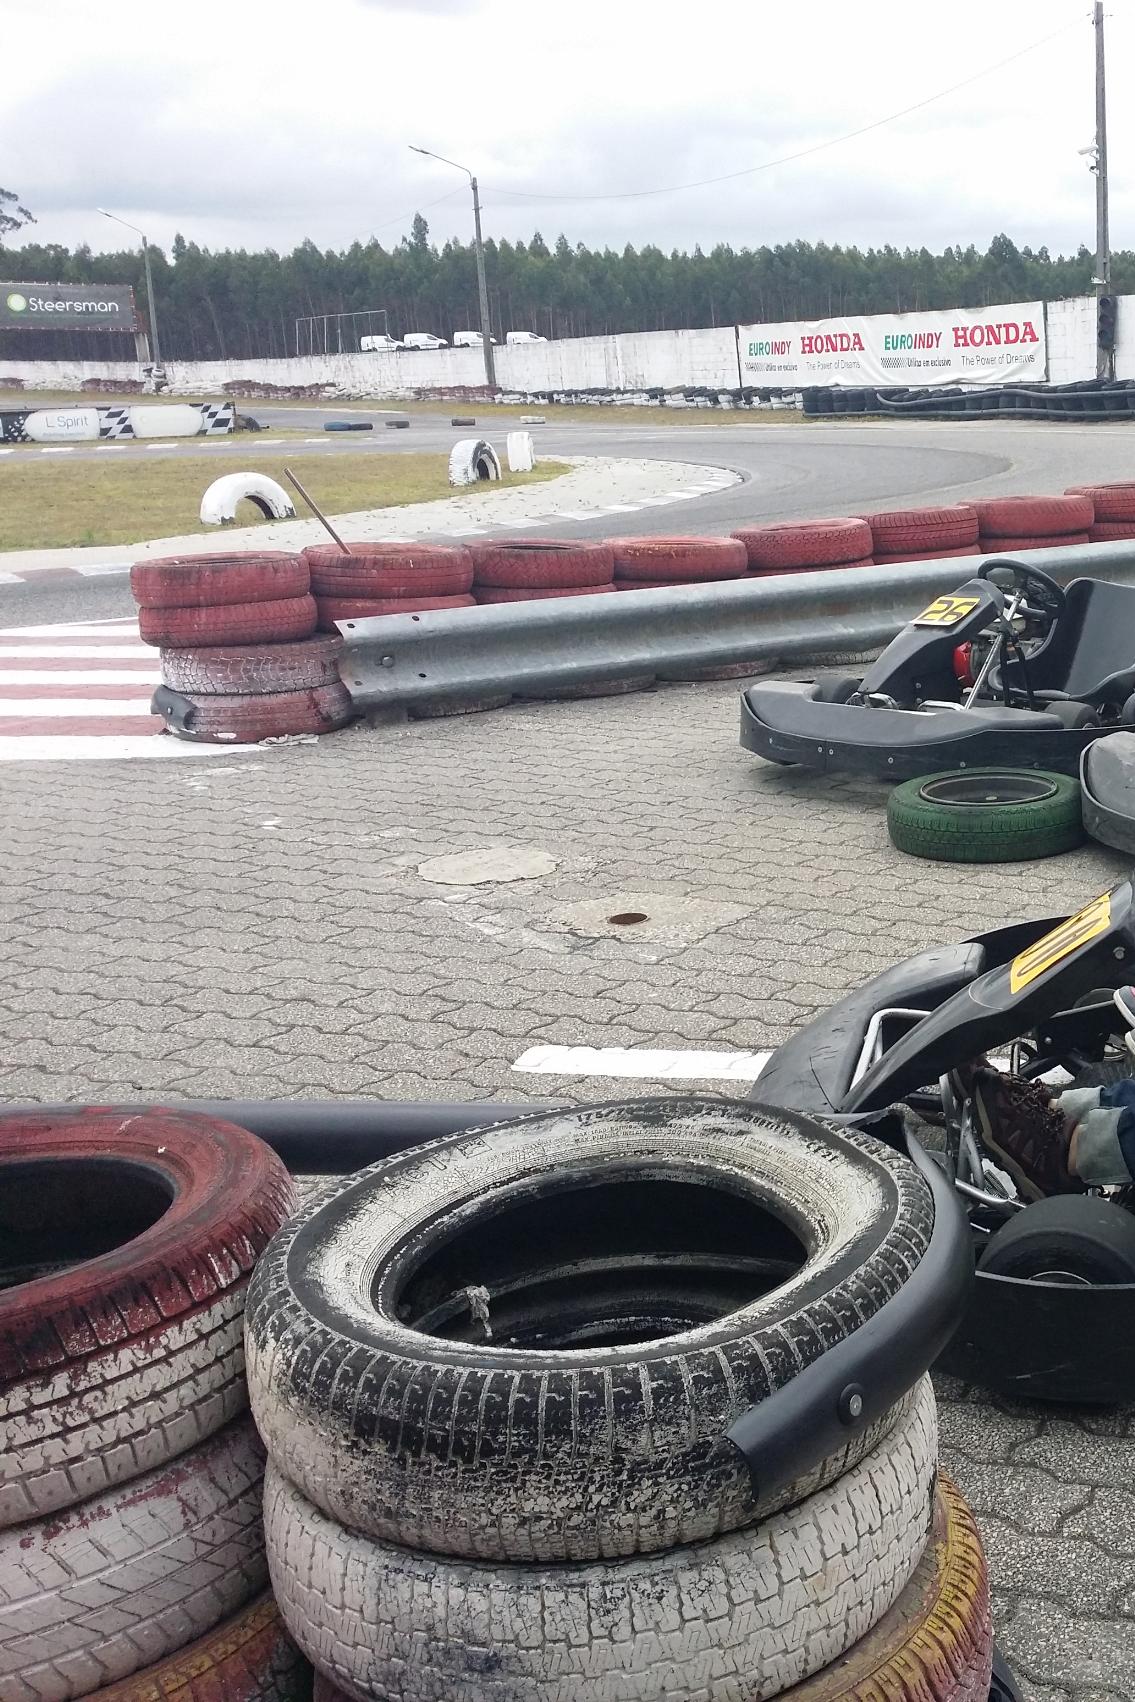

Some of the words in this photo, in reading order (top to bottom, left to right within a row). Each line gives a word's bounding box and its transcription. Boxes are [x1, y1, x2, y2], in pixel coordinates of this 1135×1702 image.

[29, 297, 119, 313] Steersman
[885, 332, 942, 350] EUROINDY
[952, 322, 1039, 348] HONDA
[749, 341, 791, 356] EUROINDY
[801, 333, 865, 354] HONDA
[806, 361, 816, 370] The
[817, 361, 832, 370] Power
[961, 355, 974, 366] The
[976, 354, 996, 366] Power
[999, 354, 1005, 364] of
[46, 415, 55, 428] L
[57, 415, 88, 430] Spirit
[917, 599, 977, 622] 26
